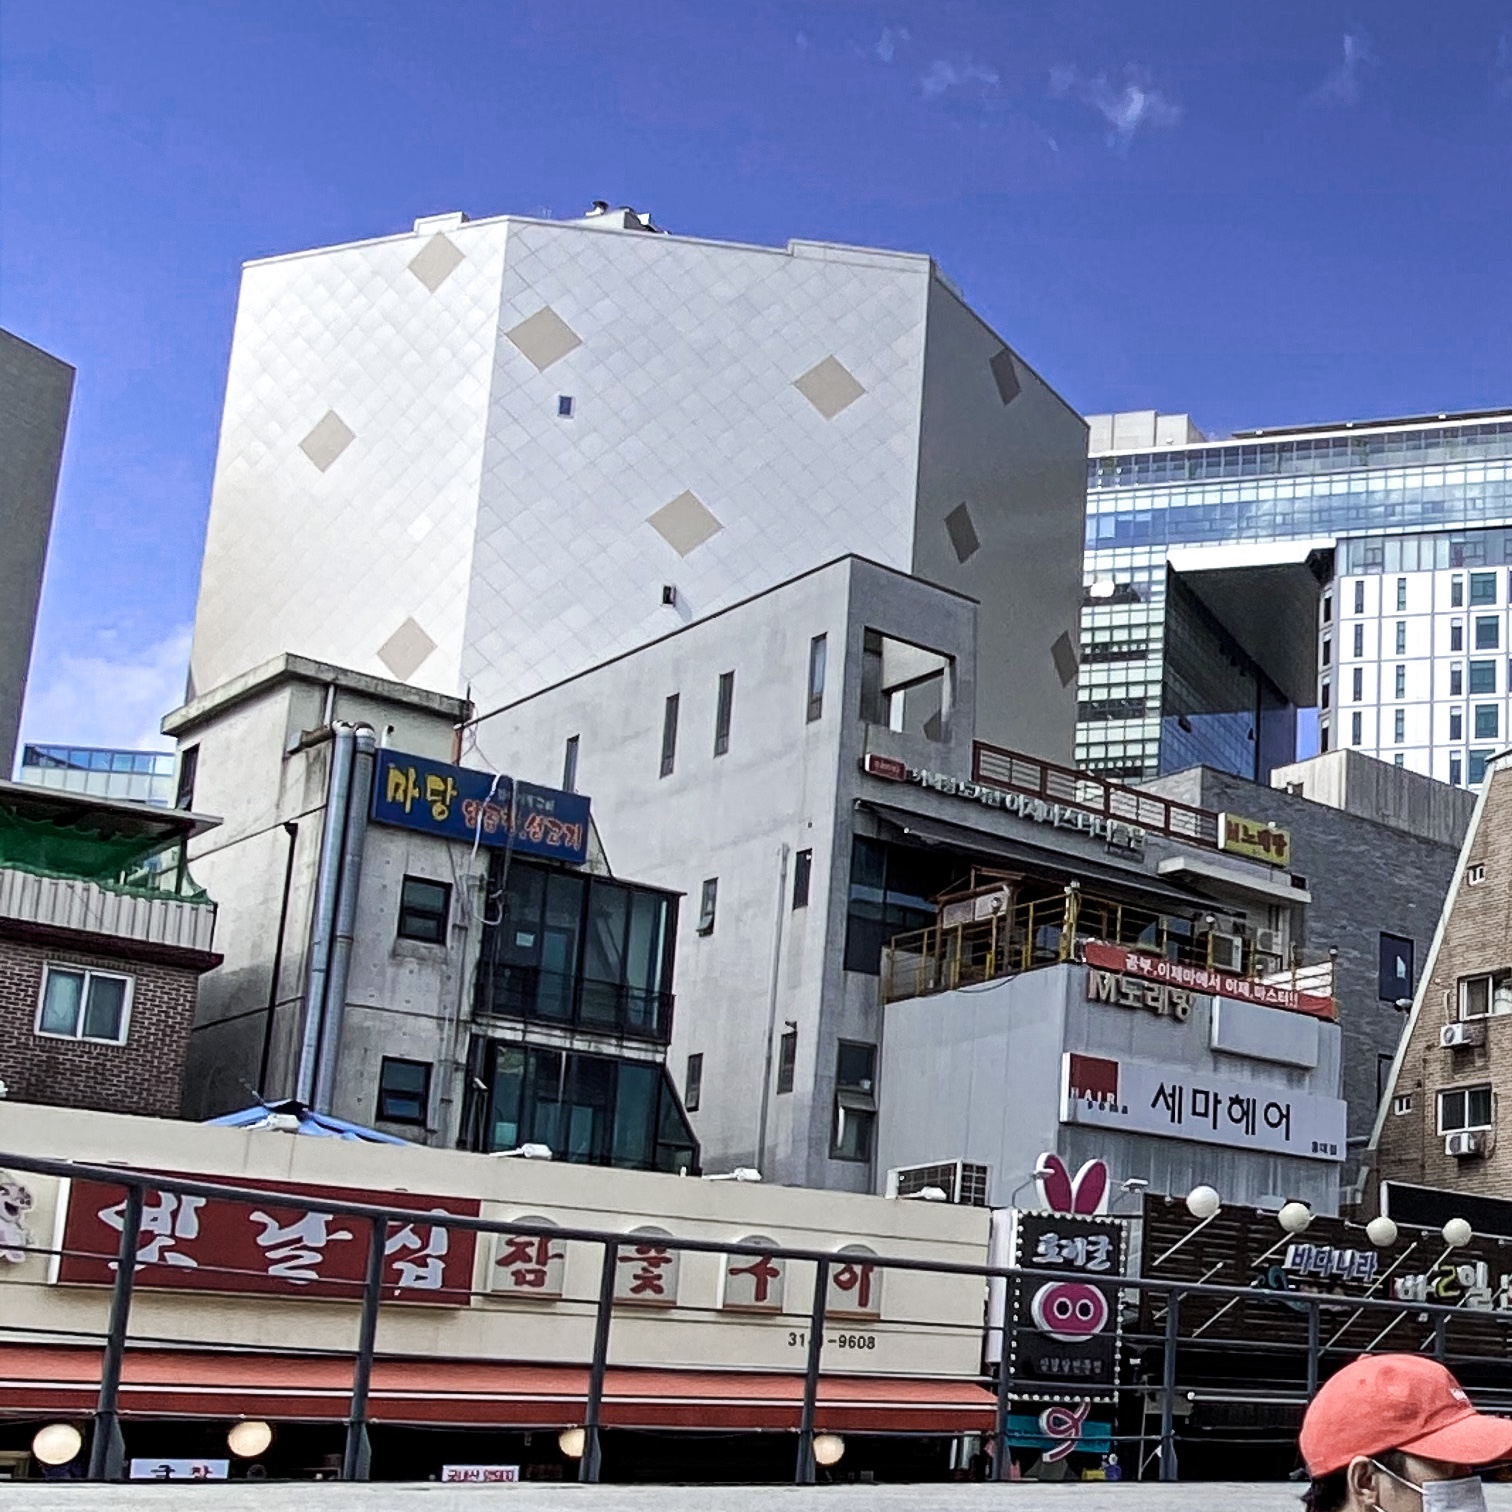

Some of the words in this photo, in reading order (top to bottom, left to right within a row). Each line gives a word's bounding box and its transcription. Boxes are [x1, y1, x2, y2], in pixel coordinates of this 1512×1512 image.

[385, 763, 458, 821] 마당
[1087, 968, 1193, 1022] M노래방
[1070, 1086, 1116, 1106] HAIR
[1150, 1081, 1291, 1142] 세마헤어
[1283, 1243, 1378, 1281] 바다나라
[787, 1331, 877, 1352] 31-9608
